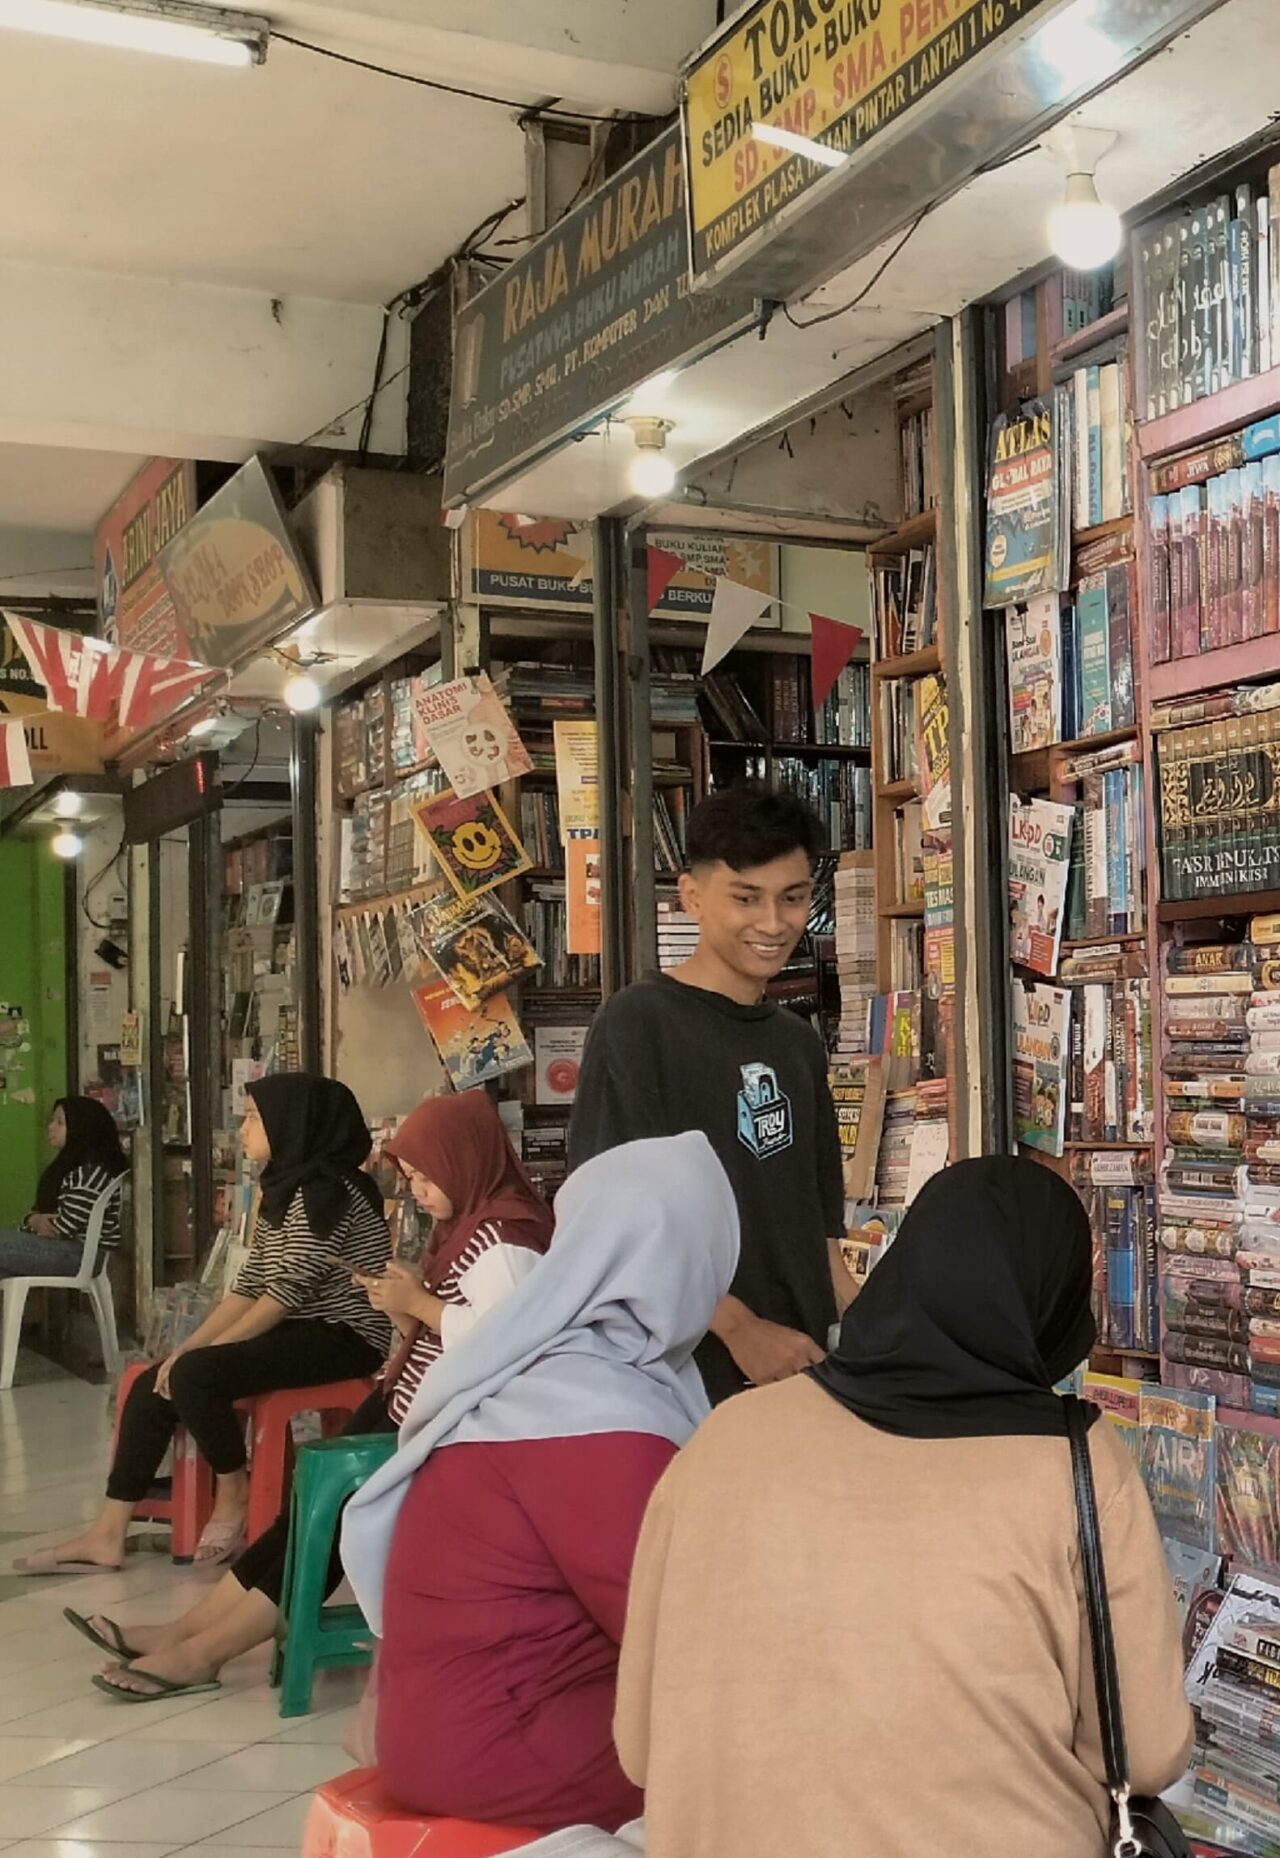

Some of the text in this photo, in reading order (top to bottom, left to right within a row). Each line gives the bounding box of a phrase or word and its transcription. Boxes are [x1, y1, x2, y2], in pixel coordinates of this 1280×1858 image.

[745, 0, 836, 80] TOK
[901, 0, 960, 45] PER
[703, 97, 752, 168] SEDIA
[706, 193, 761, 257] KOMPLEK
[764, 166, 804, 210] PLASA
[855, 77, 906, 140] PINTAR
[911, 30, 964, 85] LANTAI
[504, 145, 684, 341] RAJA MURAH
[620, 230, 679, 301] MURAH
[995, 410, 1050, 463] ATLAS
[155, 470, 187, 551] JAYA
[490, 574, 534, 589] PUSAT
[415, 682, 468, 708] ANATOMI
[418, 697, 459, 718] KLINIS
[423, 705, 462, 725] DASAR
[754, 1109, 785, 1139] TROY
